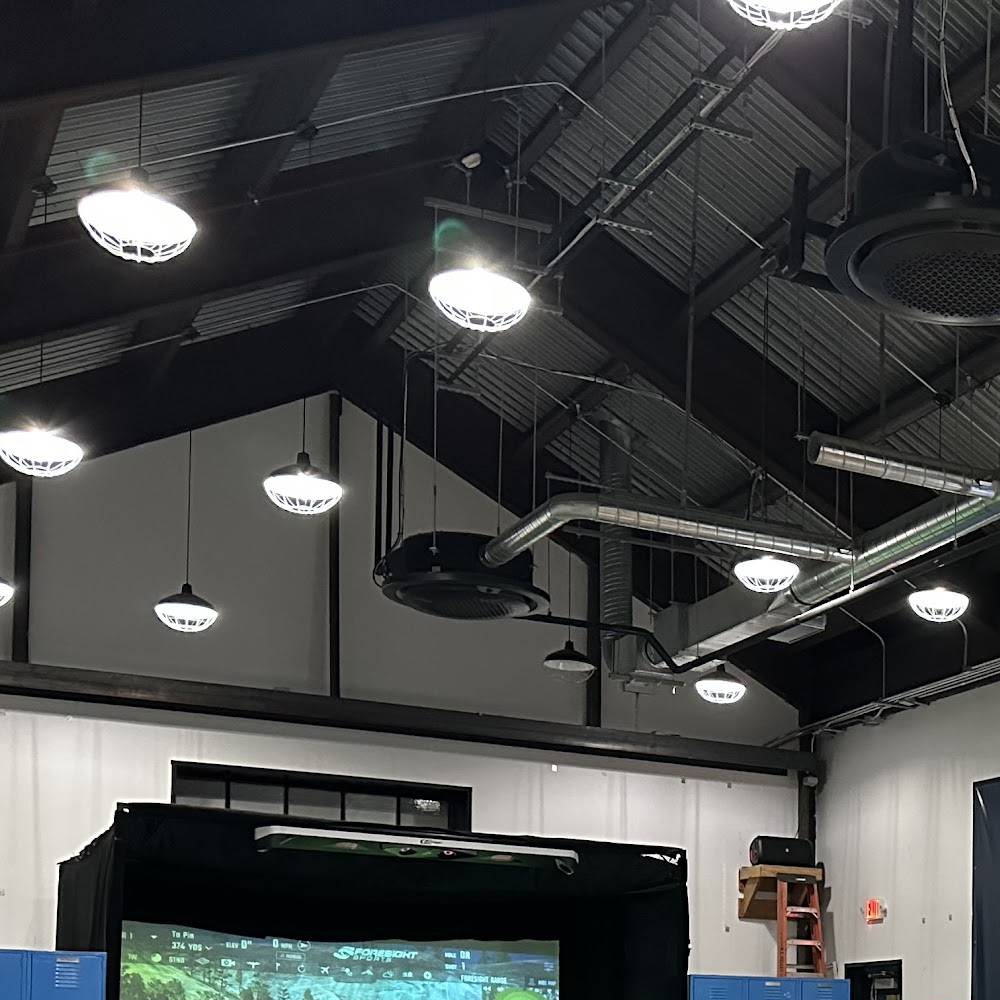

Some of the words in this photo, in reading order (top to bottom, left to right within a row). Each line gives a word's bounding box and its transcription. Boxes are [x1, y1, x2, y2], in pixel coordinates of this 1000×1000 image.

[171, 941, 186, 949] 374
[188, 943, 203, 951] YDS
[354, 948, 418, 959] FORESIGHT
